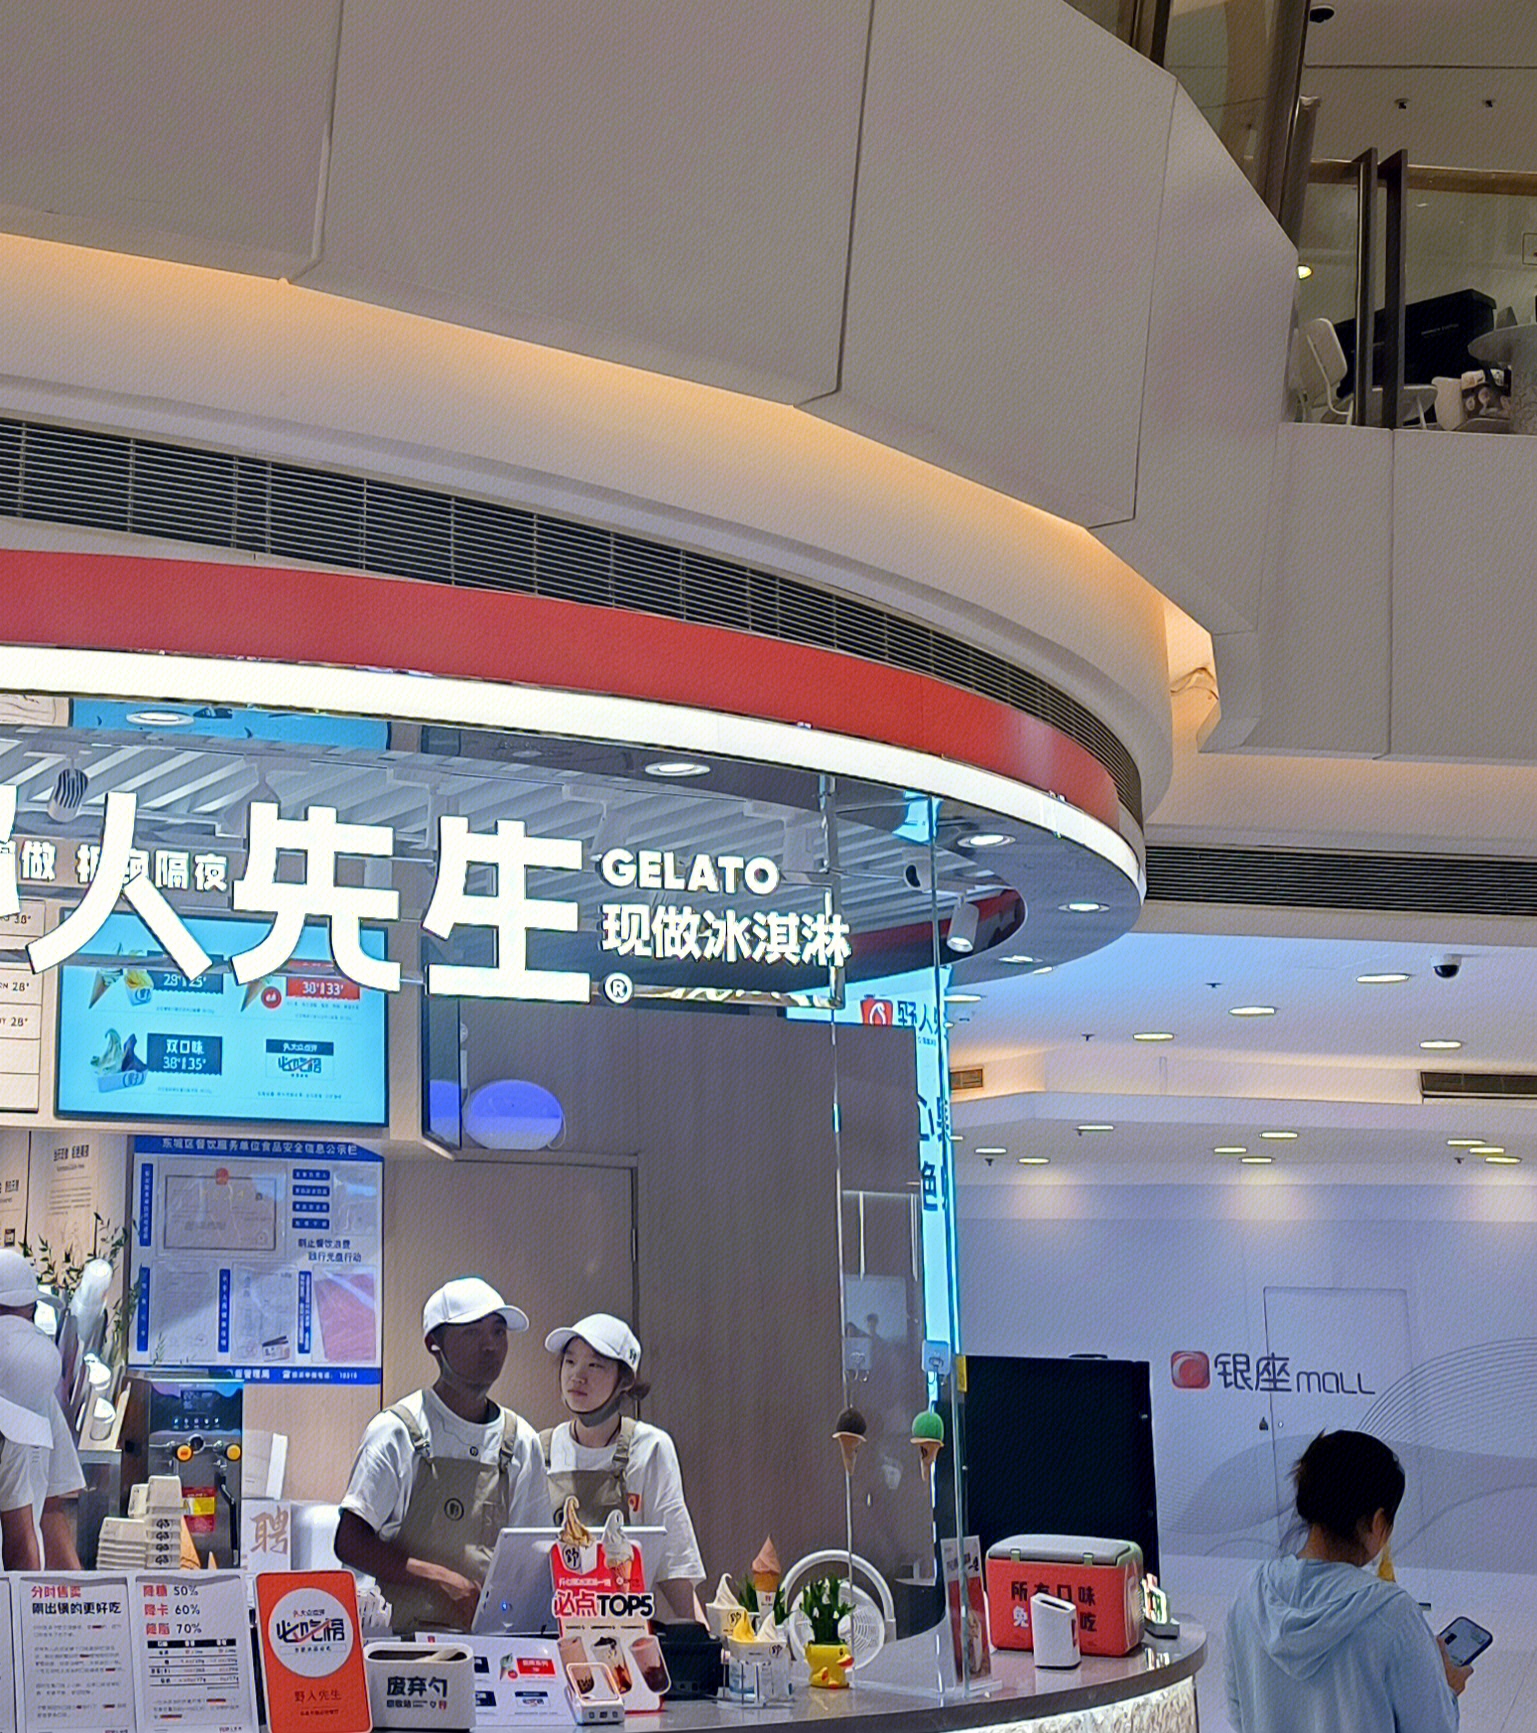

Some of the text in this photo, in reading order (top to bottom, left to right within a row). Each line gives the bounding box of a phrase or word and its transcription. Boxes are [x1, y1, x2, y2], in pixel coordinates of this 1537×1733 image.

[601, 848, 780, 895] GELATO
[601, 904, 851, 967] 现做冰淇淋
[165, 1038, 205, 1055] 双口味
[1214, 1352, 1292, 1392] 银座
[250, 1506, 290, 1555] 聘
[31, 1585, 82, 1599] 分时售卖
[173, 1585, 199, 1597] 50%
[32, 1601, 122, 1615] 刚出锅的更好吃
[174, 1604, 201, 1616] 60%
[176, 1622, 203, 1635] 70%
[276, 1617, 346, 1644] 必吃榜
[386, 1675, 448, 1698] 废弃勺
[294, 1689, 342, 1703] 野人先生
